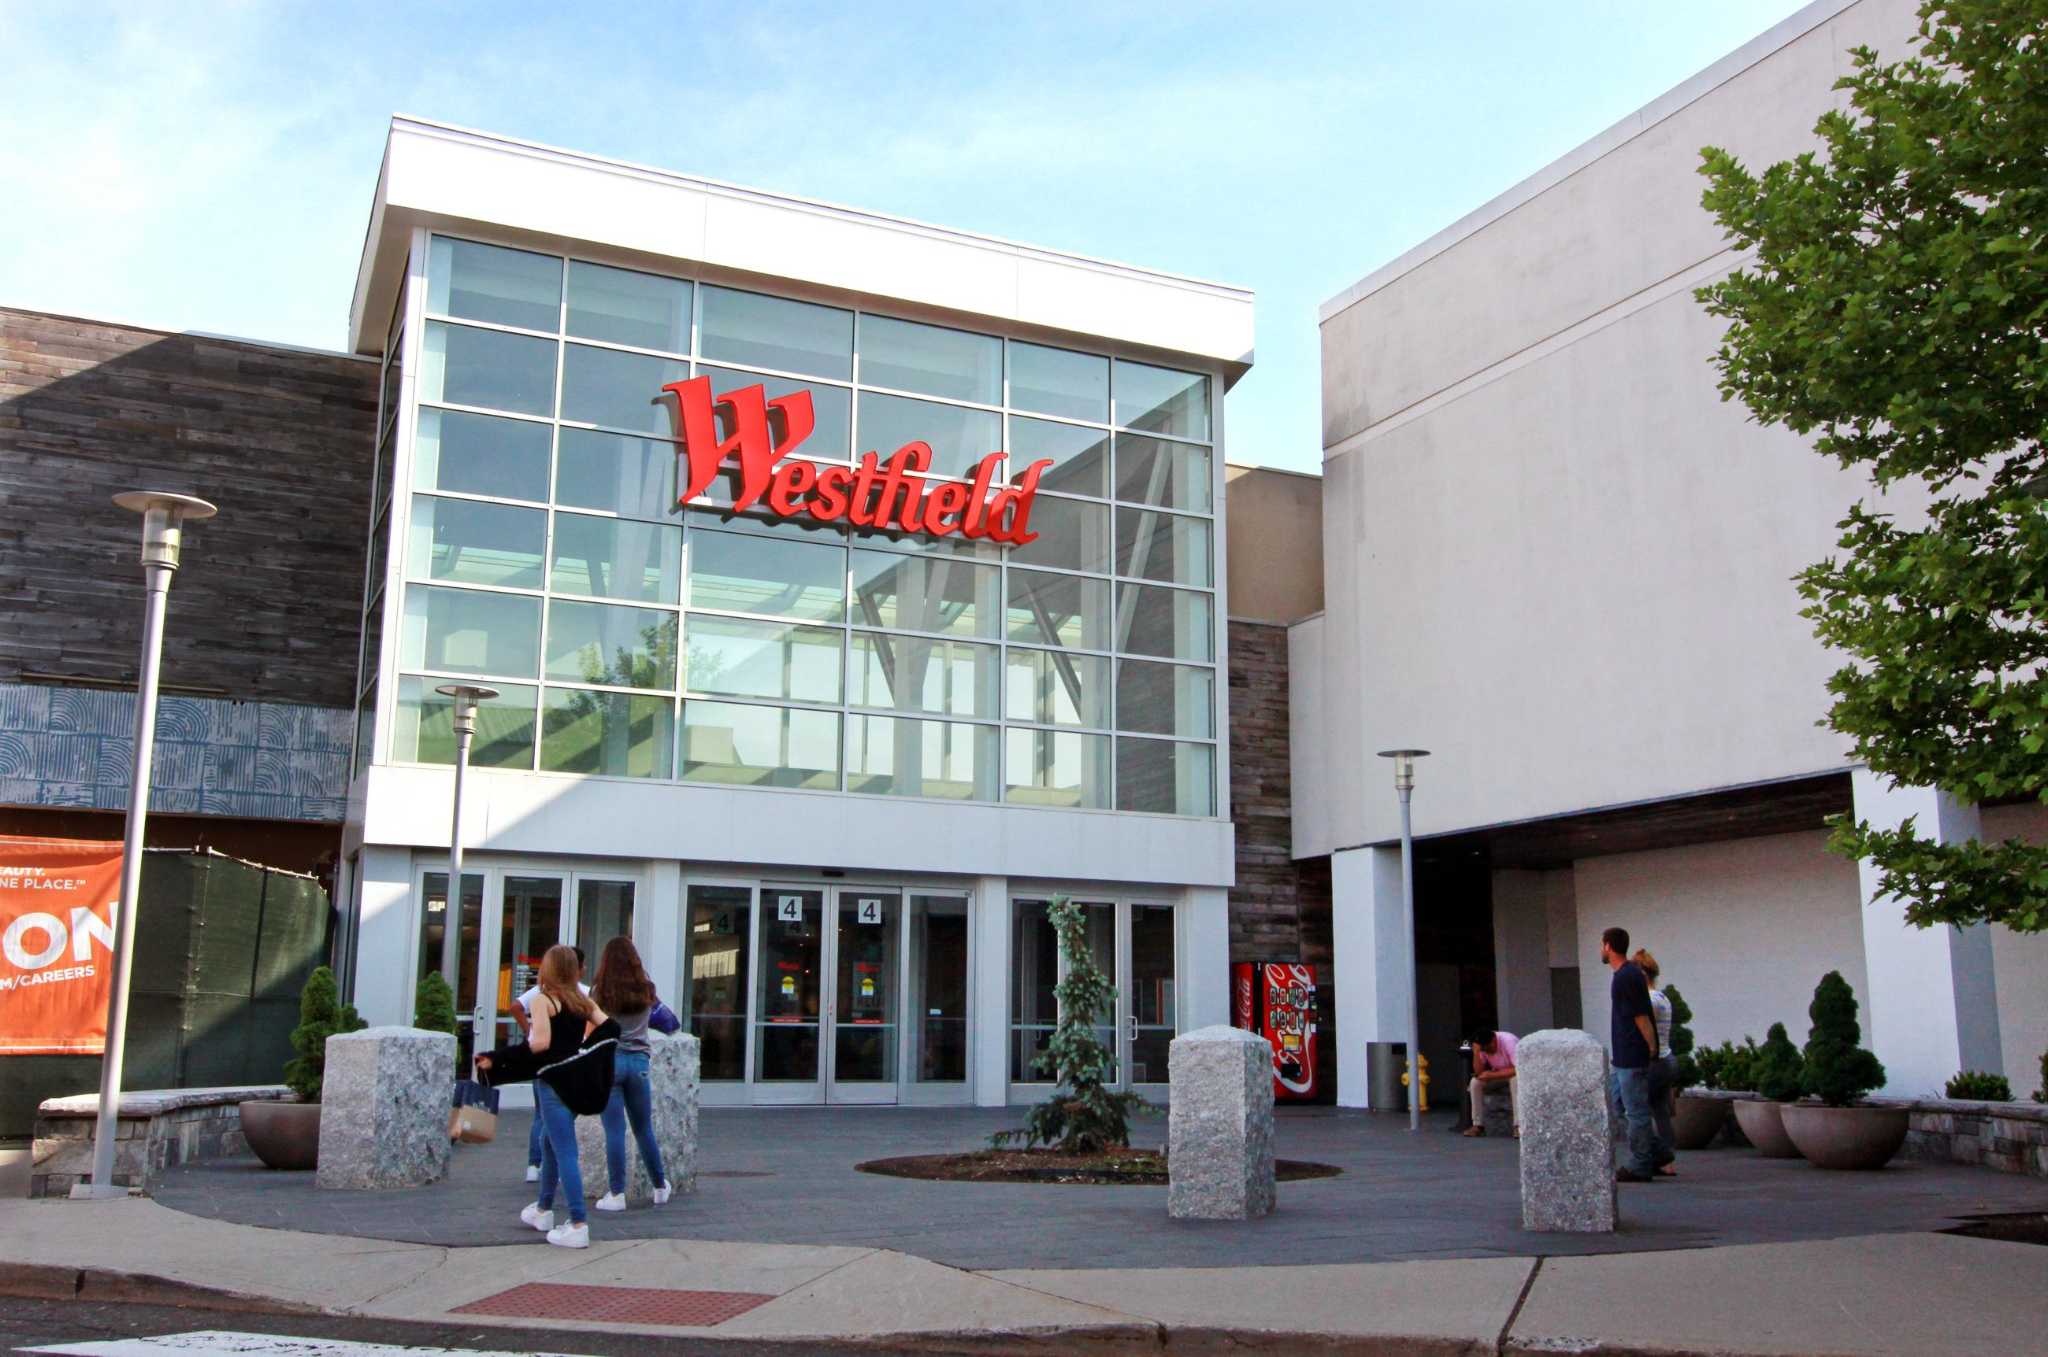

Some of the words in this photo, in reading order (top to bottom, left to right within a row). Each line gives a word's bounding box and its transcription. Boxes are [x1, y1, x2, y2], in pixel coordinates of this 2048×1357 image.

[661, 375, 1054, 545] Westfield
[784, 899, 797, 918] 4
[863, 902, 876, 921] 4
[3, 901, 118, 969] ON
